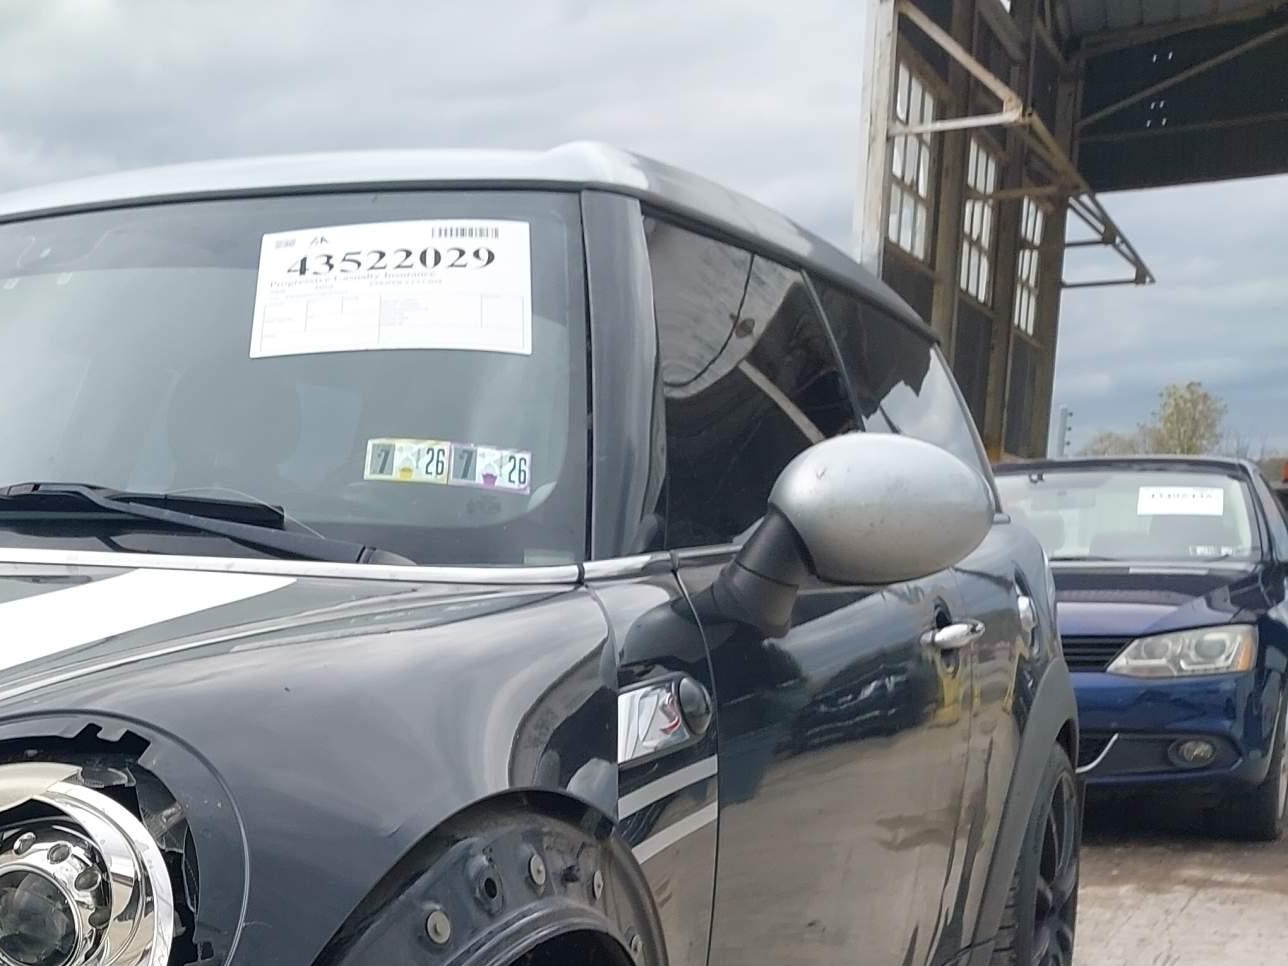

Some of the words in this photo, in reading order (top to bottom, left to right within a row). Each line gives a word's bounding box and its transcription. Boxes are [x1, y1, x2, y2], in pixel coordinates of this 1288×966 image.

[286, 246, 496, 276] 43522029
[425, 447, 446, 476] 26
[508, 455, 528, 485] 26
